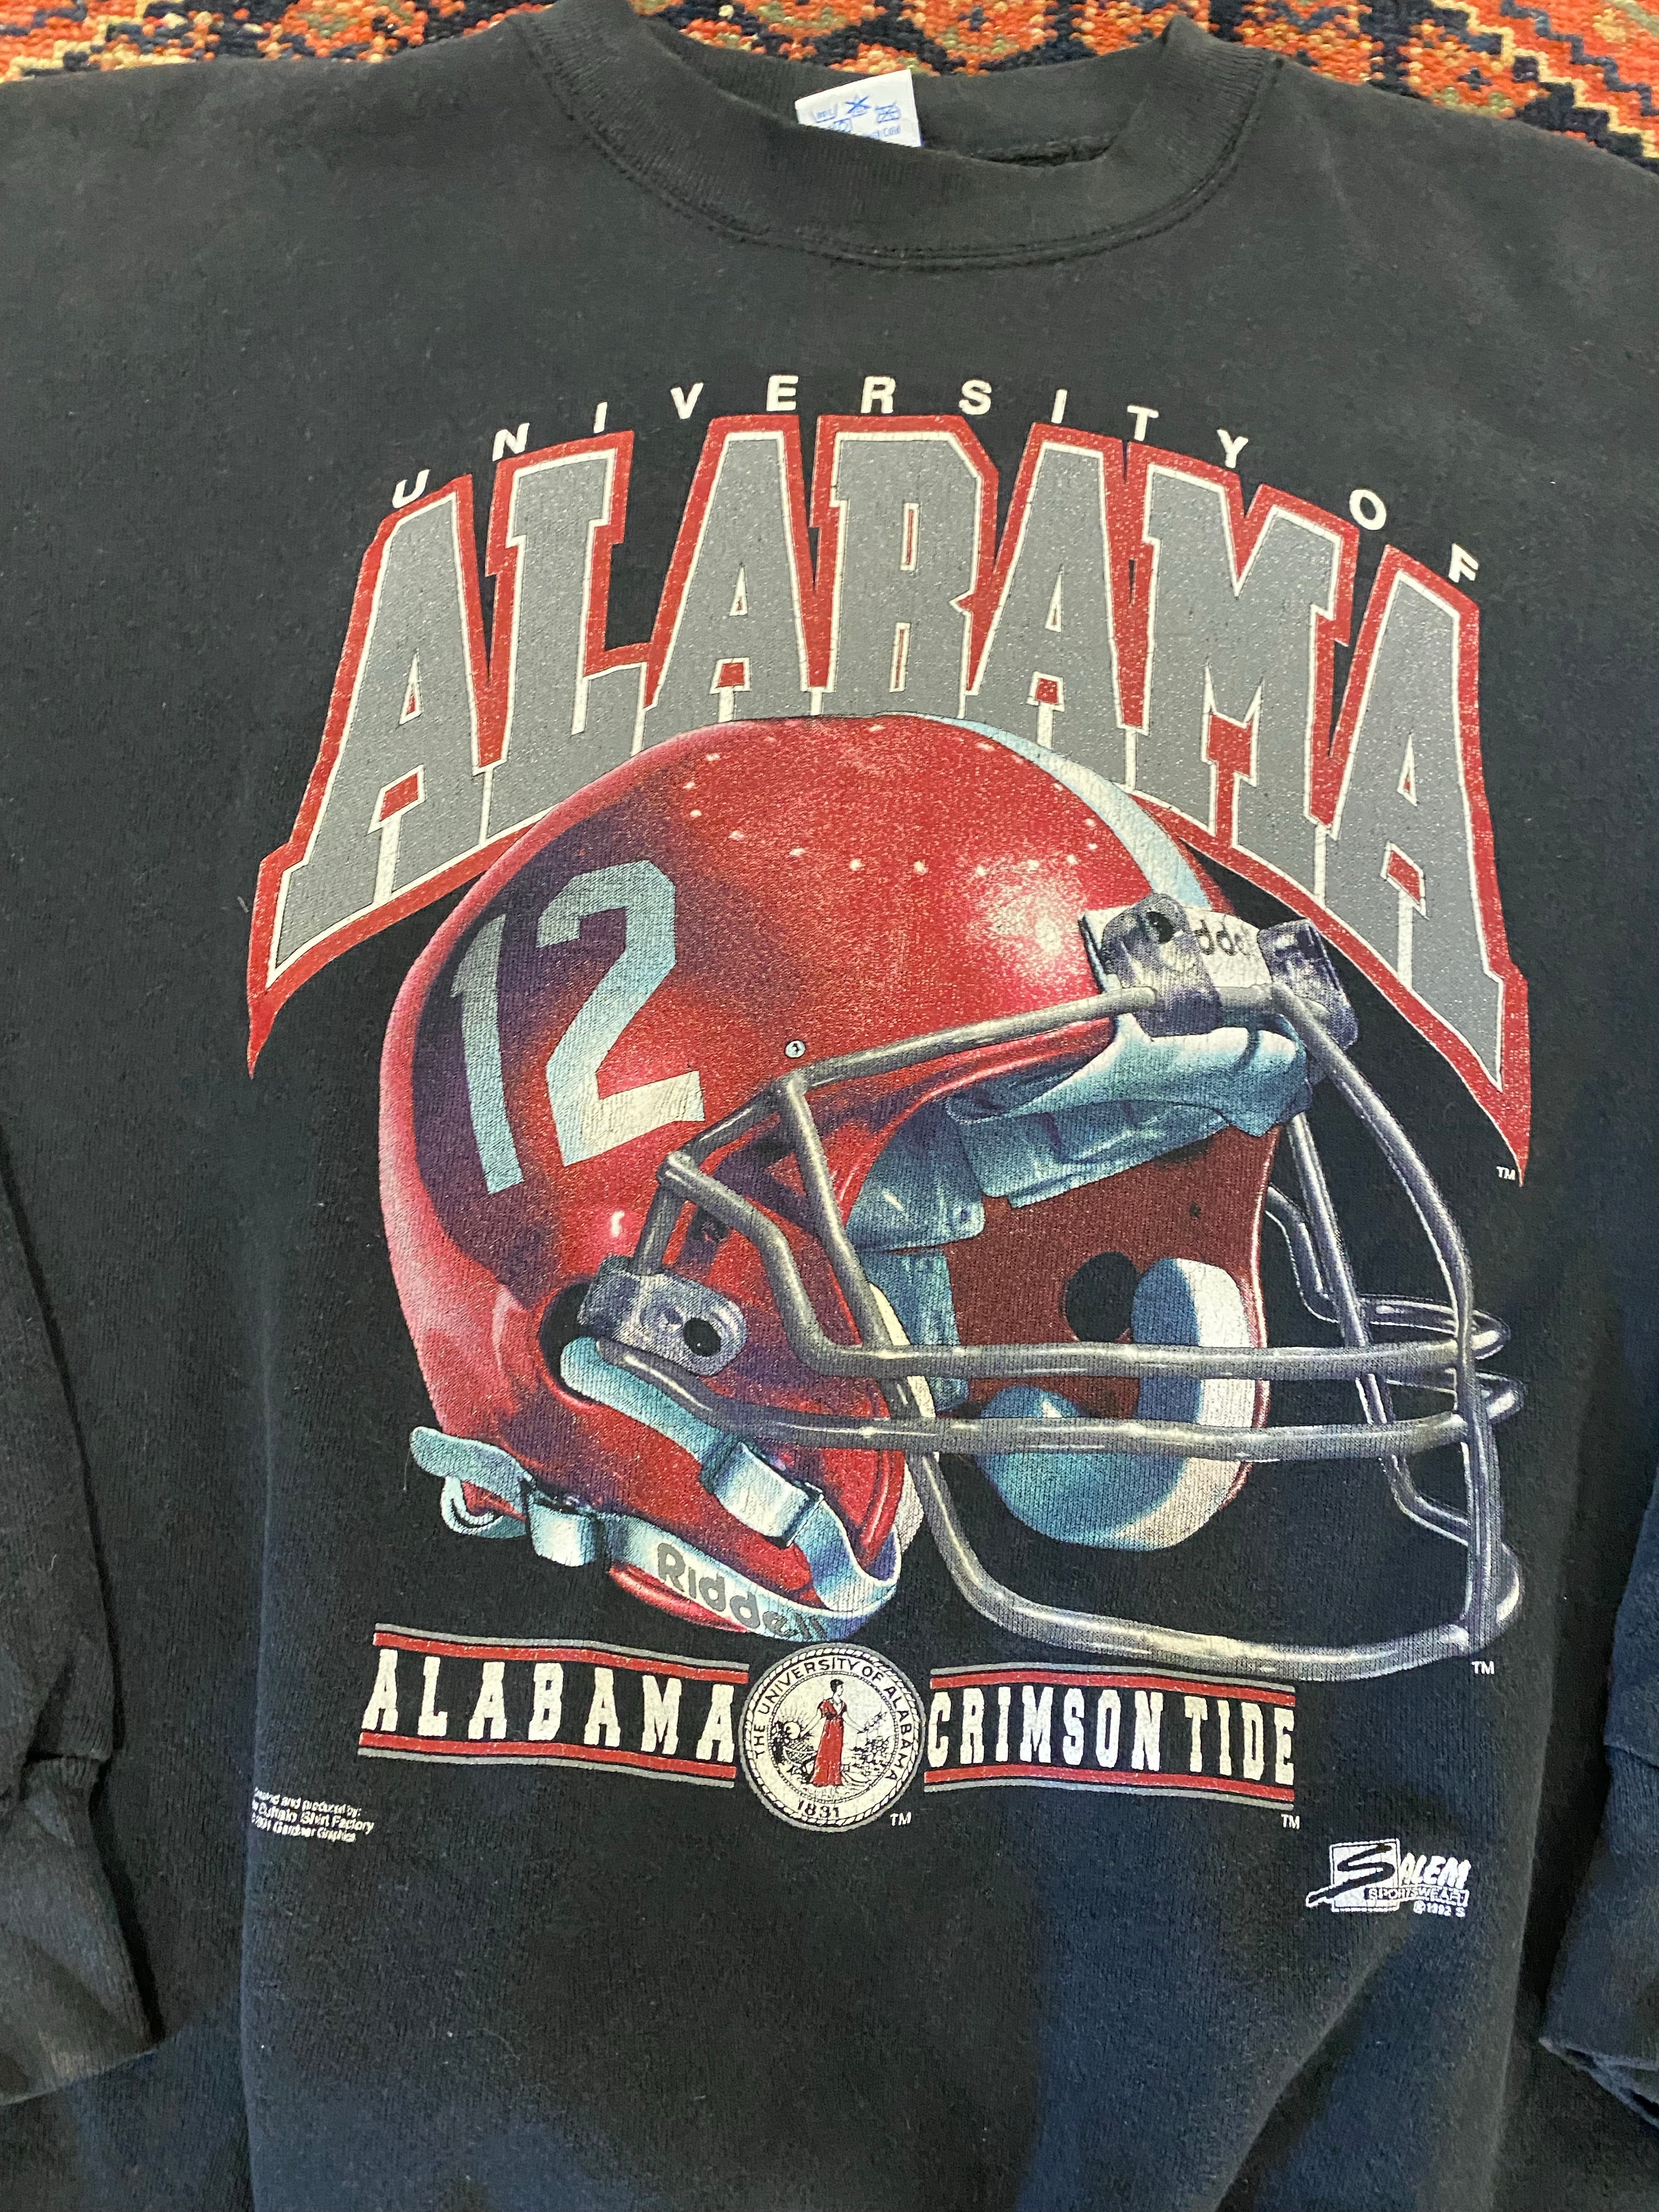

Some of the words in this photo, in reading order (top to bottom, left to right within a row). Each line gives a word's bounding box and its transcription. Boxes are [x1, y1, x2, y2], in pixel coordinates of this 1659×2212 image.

[392, 375, 1248, 509] UNIVERSITY
[1348, 488, 1479, 583] OF
[250, 414, 1531, 1130] ALABAMA
[450, 860, 706, 1194] 12
[1496, 1166, 1516, 1180] TM
[657, 1542, 825, 1640] Riddell
[758, 1656, 860, 1715] UNIVERSITY
[861, 1665, 886, 1682] OF
[1471, 1661, 1495, 1674] TM
[360, 1648, 735, 1763] ALABAMA
[883, 1685, 913, 1781] ALABAMA
[753, 1723, 767, 1759] THE
[927, 1685, 1164, 1772] CRIMSON
[1184, 1695, 1295, 1786] TIDE
[331, 1814, 375, 1835] Factory
[890, 1812, 912, 1826] TM
[1281, 1814, 1300, 1830] TM
